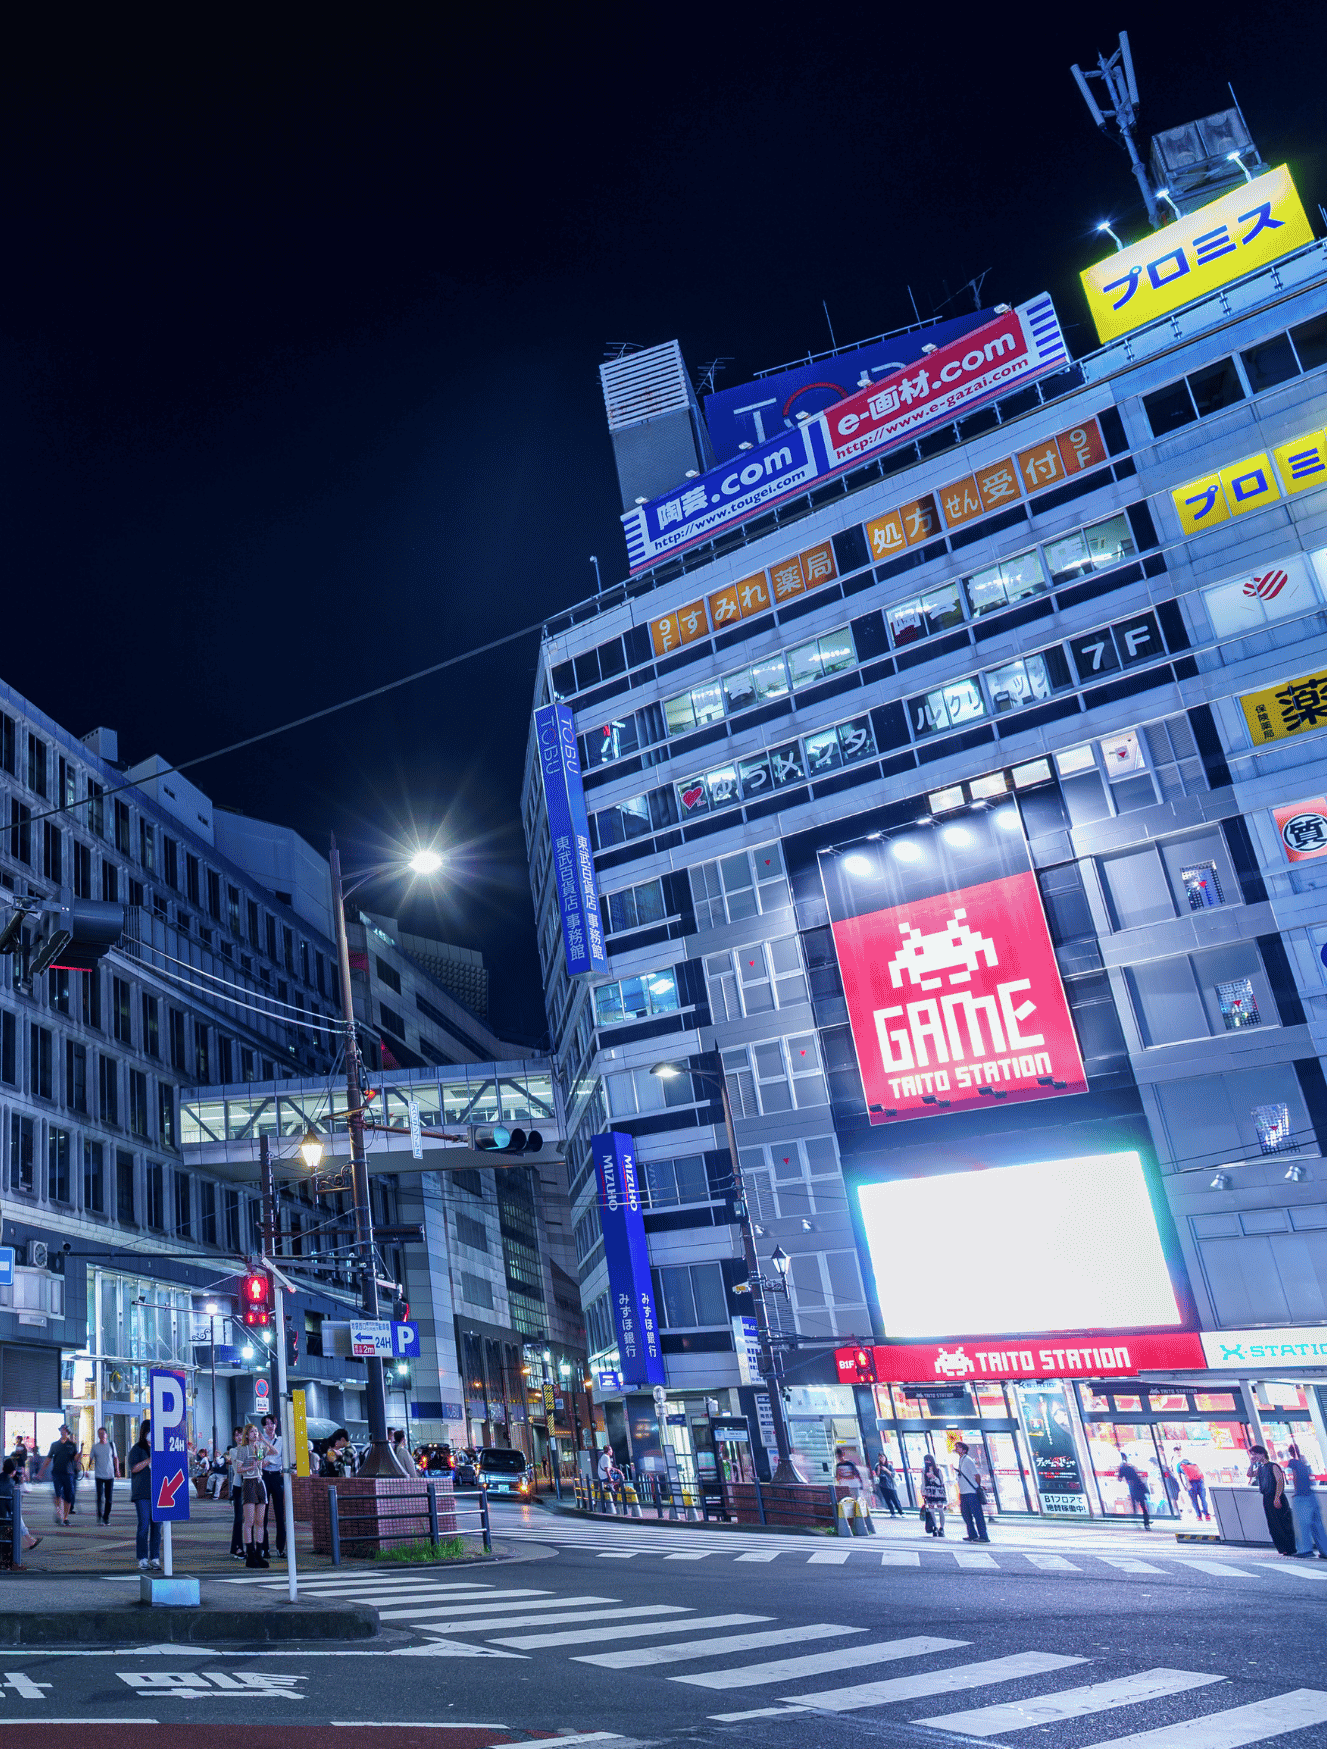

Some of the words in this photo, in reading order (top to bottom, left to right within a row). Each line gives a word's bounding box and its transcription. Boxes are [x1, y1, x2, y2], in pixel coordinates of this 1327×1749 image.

[1103, 201, 1286, 311] プロミス
[836, 357, 1029, 460] http://www.e-gazai.com
[837, 332, 1016, 435] e-画材.com
[654, 469, 806, 551] http://www.tougei.com
[656, 446, 793, 531] 陶芸.com
[873, 452, 1058, 554] 処方せん受付
[1069, 429, 1091, 471] 9F
[1185, 447, 1327, 521] プロミ
[658, 618, 673, 653] 9F
[682, 551, 832, 635] すみれ薬局
[1082, 626, 1150, 670] 7F
[541, 715, 561, 776] TOBU
[562, 718, 579, 775] TOBU
[1289, 819, 1327, 850] 質
[555, 835, 578, 913] 東武百貨店
[576, 834, 597, 911] 東武百貨店
[565, 912, 586, 962] 事務館
[586, 912, 604, 962] 事務館
[873, 978, 1045, 1074] GAME
[888, 1070, 950, 1099] TAITO
[955, 1052, 1052, 1088] STATION
[603, 1154, 617, 1212] MIZUHO
[624, 1154, 638, 1212] MIZUHO
[375, 1336, 391, 1348] 24H
[397, 1326, 414, 1353] P
[618, 1293, 636, 1358] みずほ銀行
[641, 1292, 657, 1358] みずほ銀行
[839, 1360, 854, 1369] B1F
[975, 1351, 1035, 1372] TAITO
[1039, 1347, 1132, 1370] STATION
[153, 1376, 183, 1452] P
[169, 1436, 185, 1452] 24H
